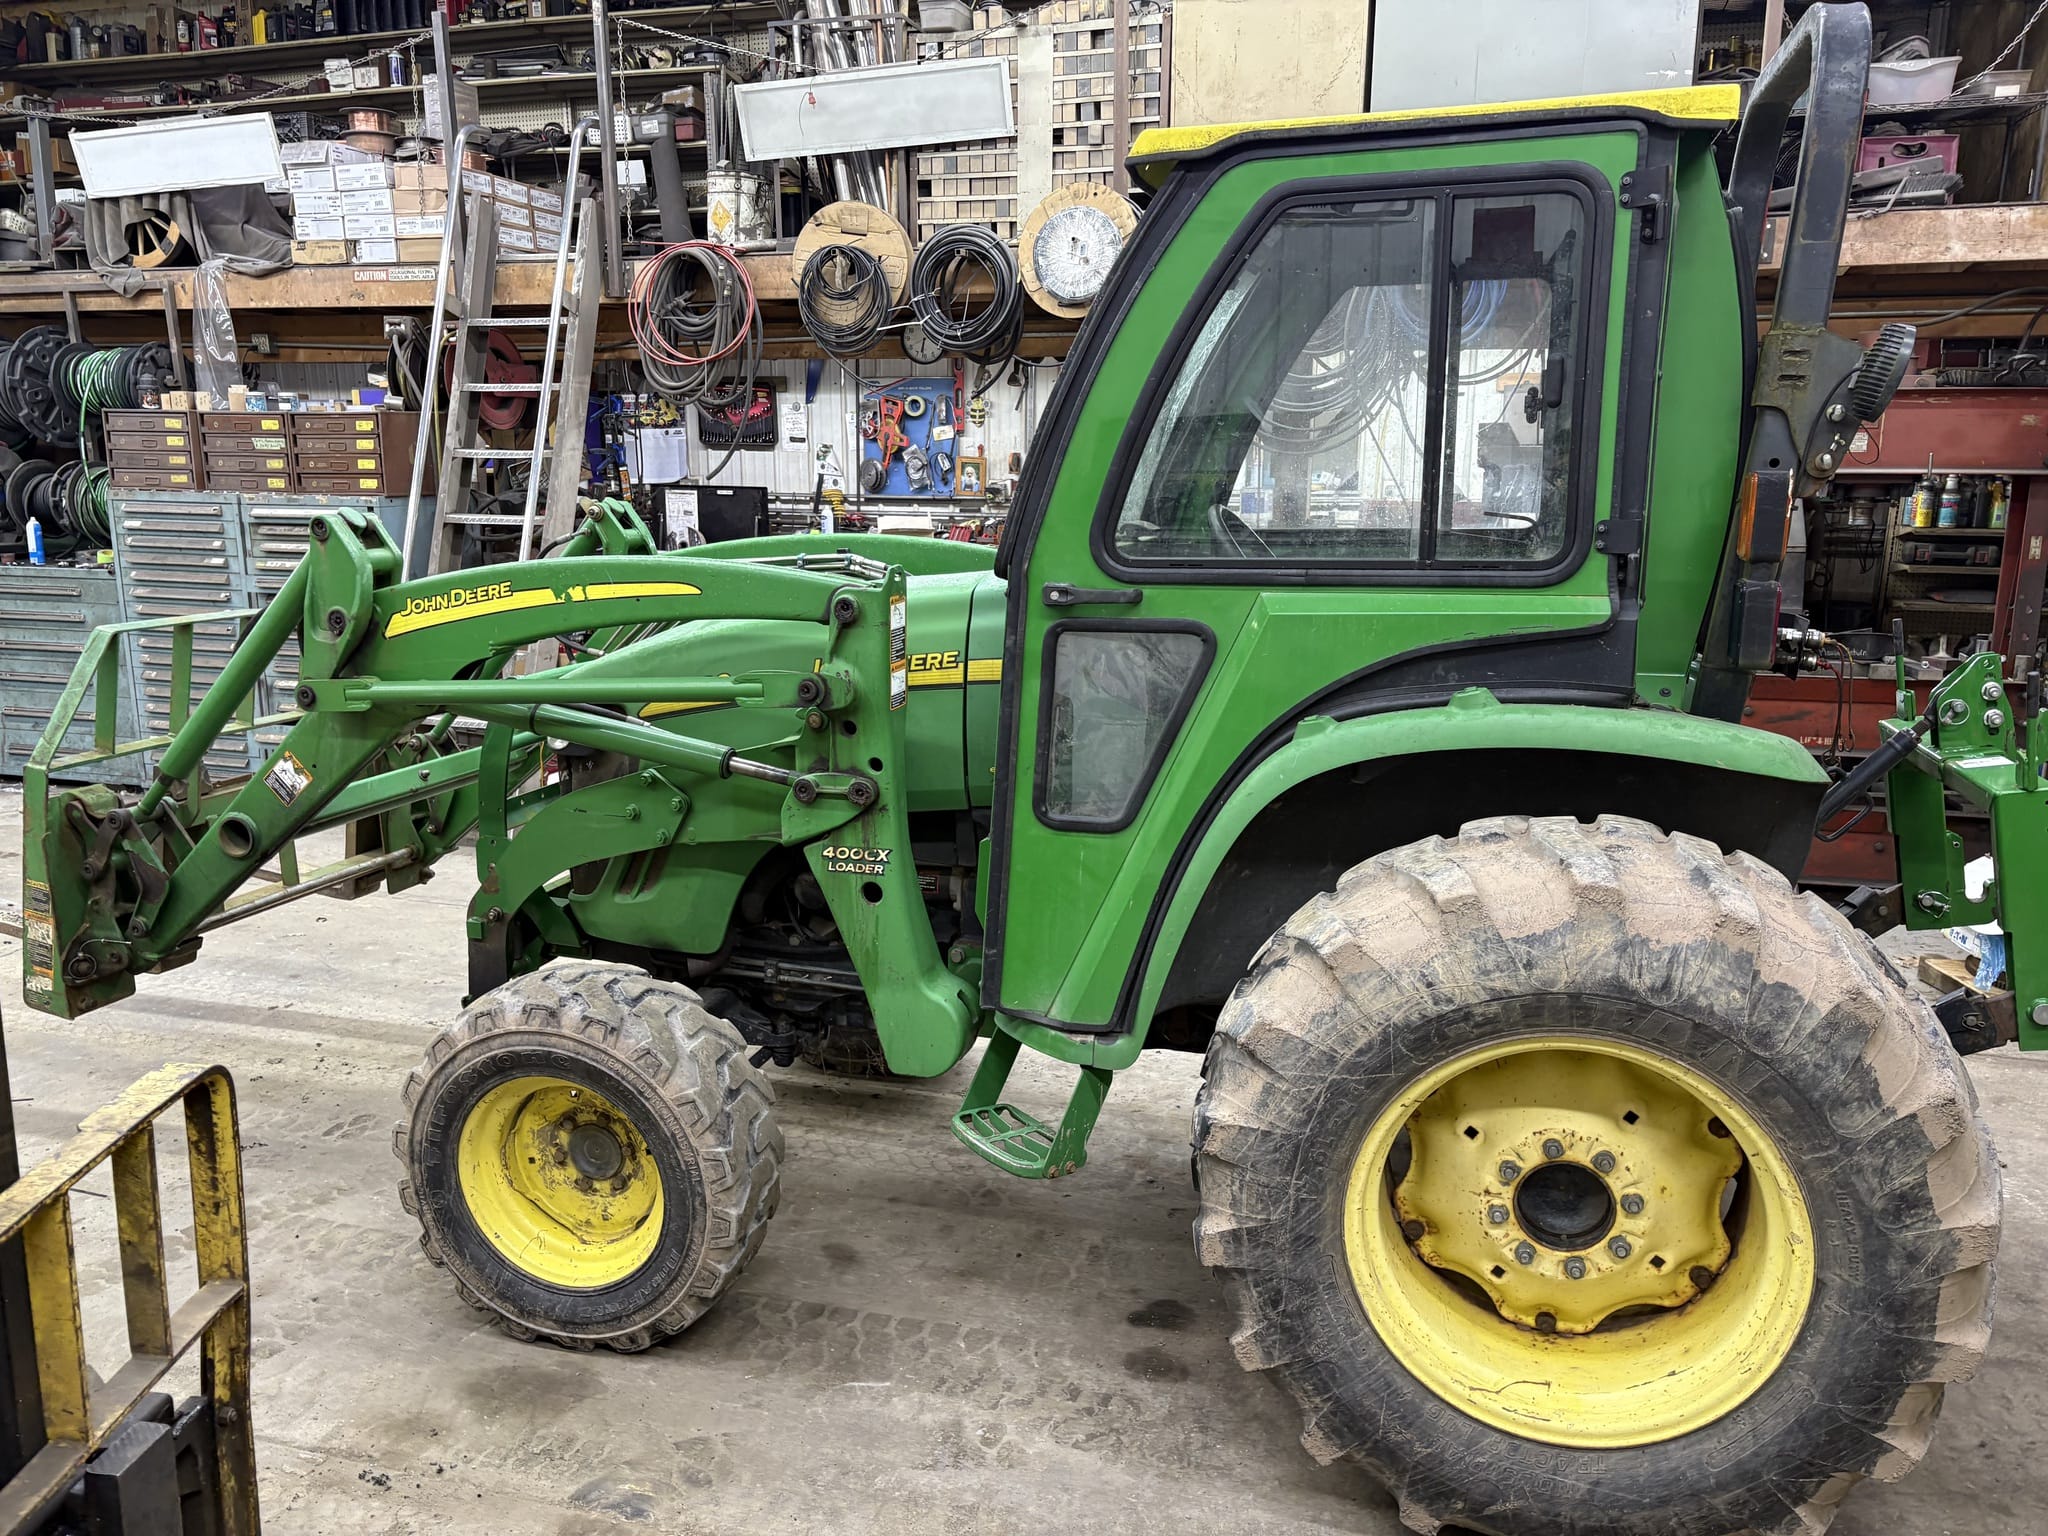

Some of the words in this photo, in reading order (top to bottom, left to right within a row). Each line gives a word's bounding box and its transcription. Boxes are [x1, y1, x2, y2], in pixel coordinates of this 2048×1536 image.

[354, 270, 387, 281] CAUTION
[400, 592, 449, 617] JOHN
[449, 580, 513, 607] DEERE
[907, 650, 960, 672] ERE
[822, 846, 891, 862] 400CX
[828, 861, 884, 874] LOADER
[600, 1054, 638, 1081] HEAVY
[639, 1080, 668, 1110] DUTY
[664, 1112, 702, 1182] INDUSTRIAL
